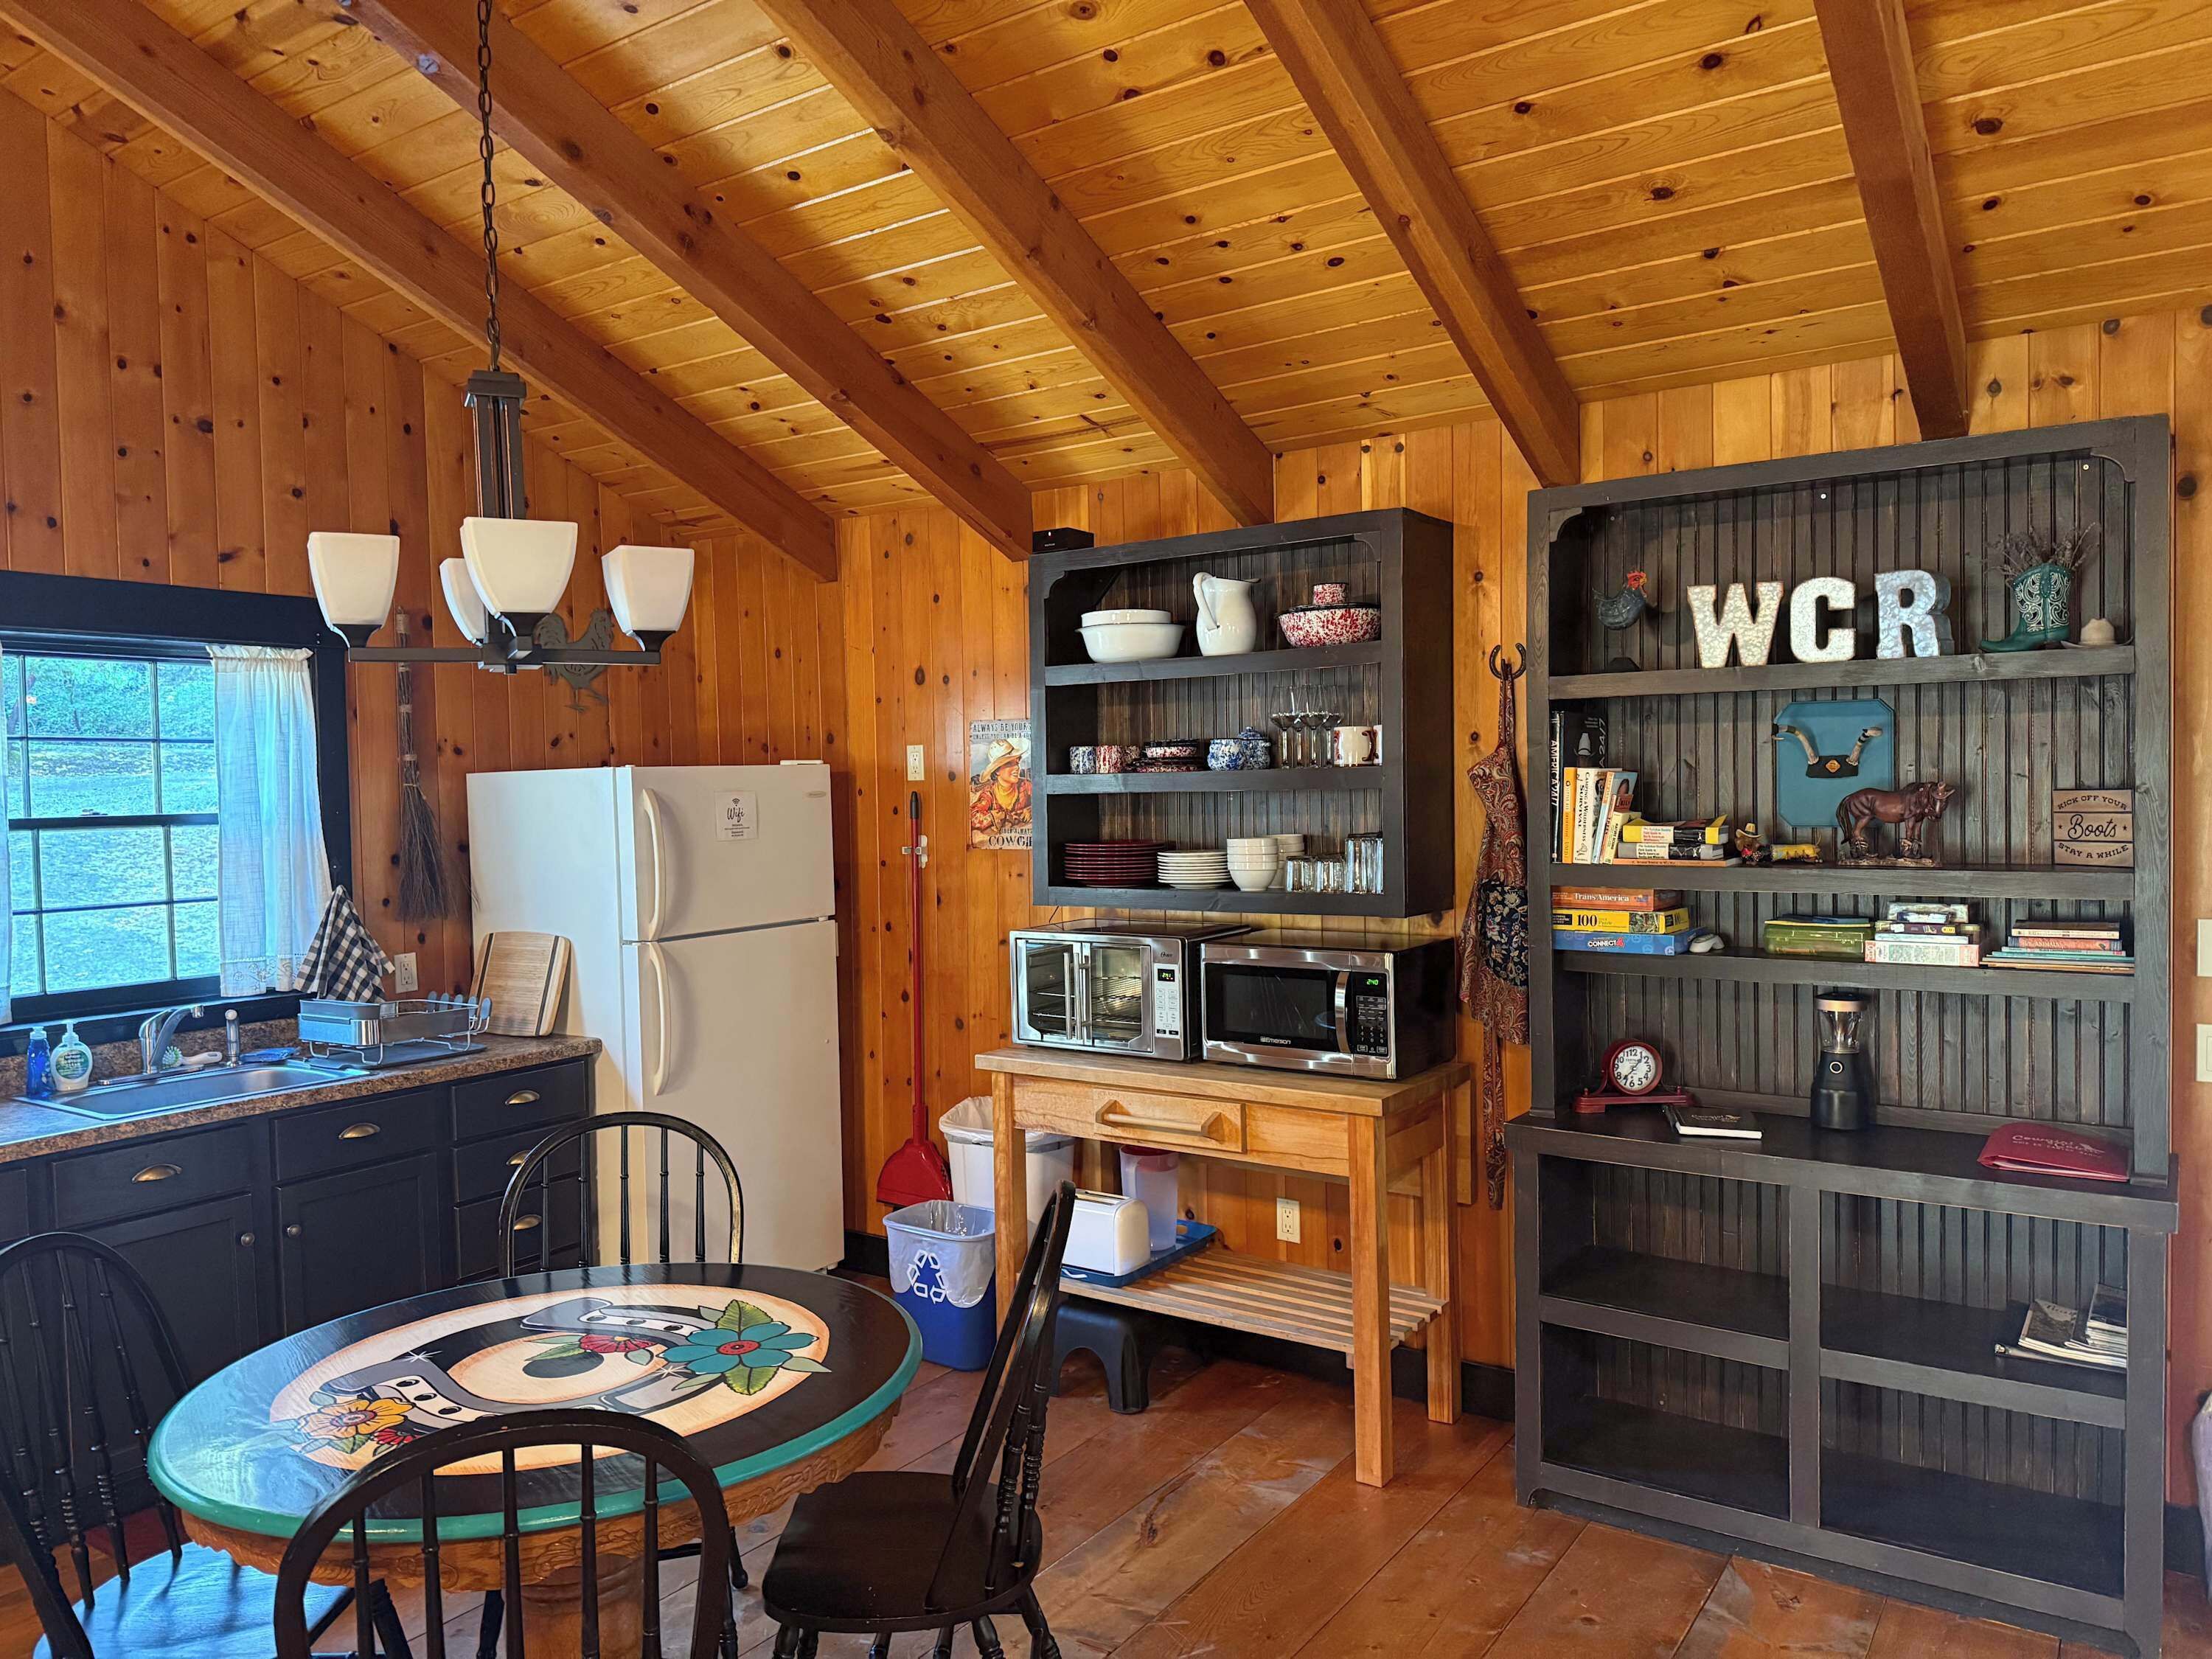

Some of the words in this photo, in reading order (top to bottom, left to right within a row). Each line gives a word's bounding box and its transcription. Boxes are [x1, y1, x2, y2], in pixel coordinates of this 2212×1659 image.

[1687, 569, 1947, 668] WCR
[973, 724, 998, 732] ALWAYS
[1001, 723, 1009, 731] BE
[2057, 797, 2079, 810] KICK
[2101, 796, 2128, 810] YOUR
[727, 807, 745, 823] Wifi
[2067, 813, 2118, 840] Boots
[2057, 843, 2083, 857] STAY
[2096, 844, 2129, 859] WHILE
[1576, 914, 1598, 927] 100
[1616, 936, 1624, 947] 4
[1265, 1037, 1291, 1045] Emerson
[1630, 1048, 1638, 1057] 12
[1644, 1056, 1649, 1064] 2
[1646, 1065, 1651, 1073] 3
[1629, 1079, 1635, 1088] 6
[1638, 1077, 1643, 1085] 5
